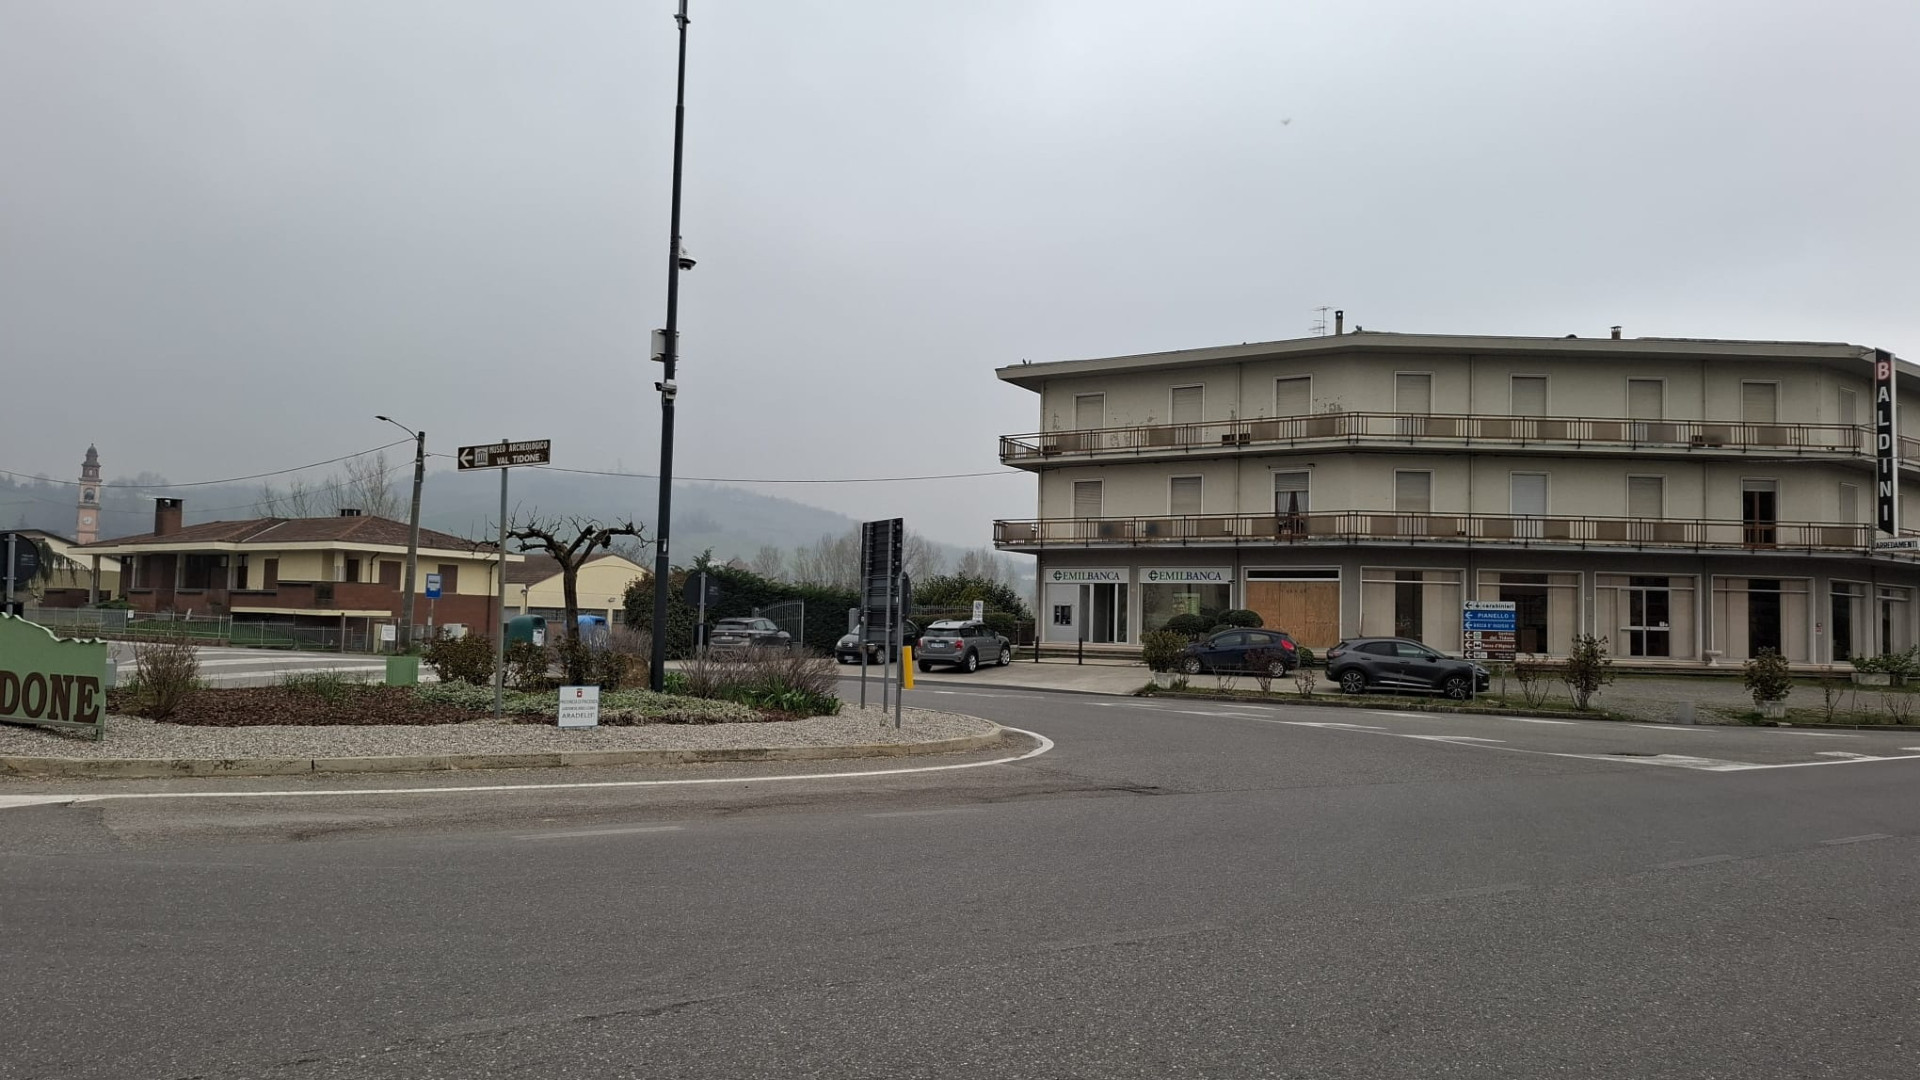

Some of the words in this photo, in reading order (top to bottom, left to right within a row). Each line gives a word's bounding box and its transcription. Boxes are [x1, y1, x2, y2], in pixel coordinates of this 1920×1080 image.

[489, 444, 506, 454] MUSEO
[508, 441, 548, 453] ARCHEOLOGICO
[1877, 362, 1892, 521] BALDINI
[496, 456, 509, 465] VAL
[512, 453, 540, 463] TIDONE
[1876, 541, 1918, 549] ARREDAMENTI
[1062, 571, 1120, 581] EMILBANCA
[1158, 571, 1222, 581] EMILBANCA
[0, 670, 99, 723] DONE
